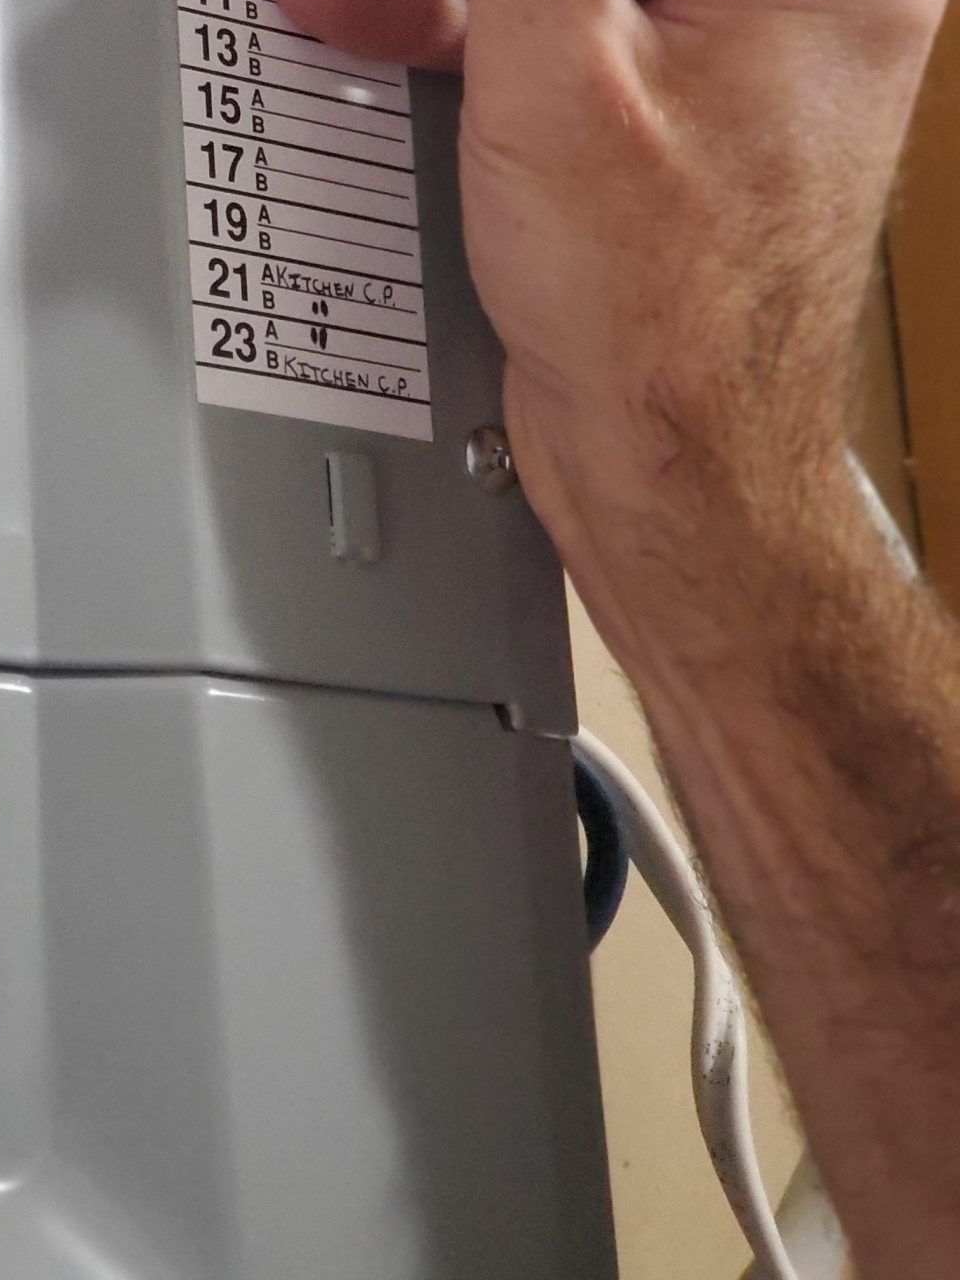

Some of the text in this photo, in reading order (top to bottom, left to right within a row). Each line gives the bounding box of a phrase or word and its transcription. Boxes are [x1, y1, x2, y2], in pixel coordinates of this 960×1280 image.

[245, 0, 259, 20] B
[194, 25, 239, 67] 13
[248, 32, 262, 51] A
[248, 57, 262, 77] B
[197, 81, 242, 124] 15
[251, 89, 265, 108] A
[252, 114, 265, 135] B
[200, 141, 245, 183] 17
[254, 146, 268, 166] A
[255, 172, 268, 192] B
[203, 199, 248, 242] 19
[257, 205, 271, 225] A
[258, 231, 272, 252] B
[207, 258, 249, 302] 21
[261, 263, 275, 283] A
[276, 265, 355, 298] KITCHEN
[262, 290, 276, 310] B
[211, 317, 257, 363] 23
[265, 320, 279, 340] A
[266, 349, 280, 370] B
[284, 354, 370, 389] KITCHEN
